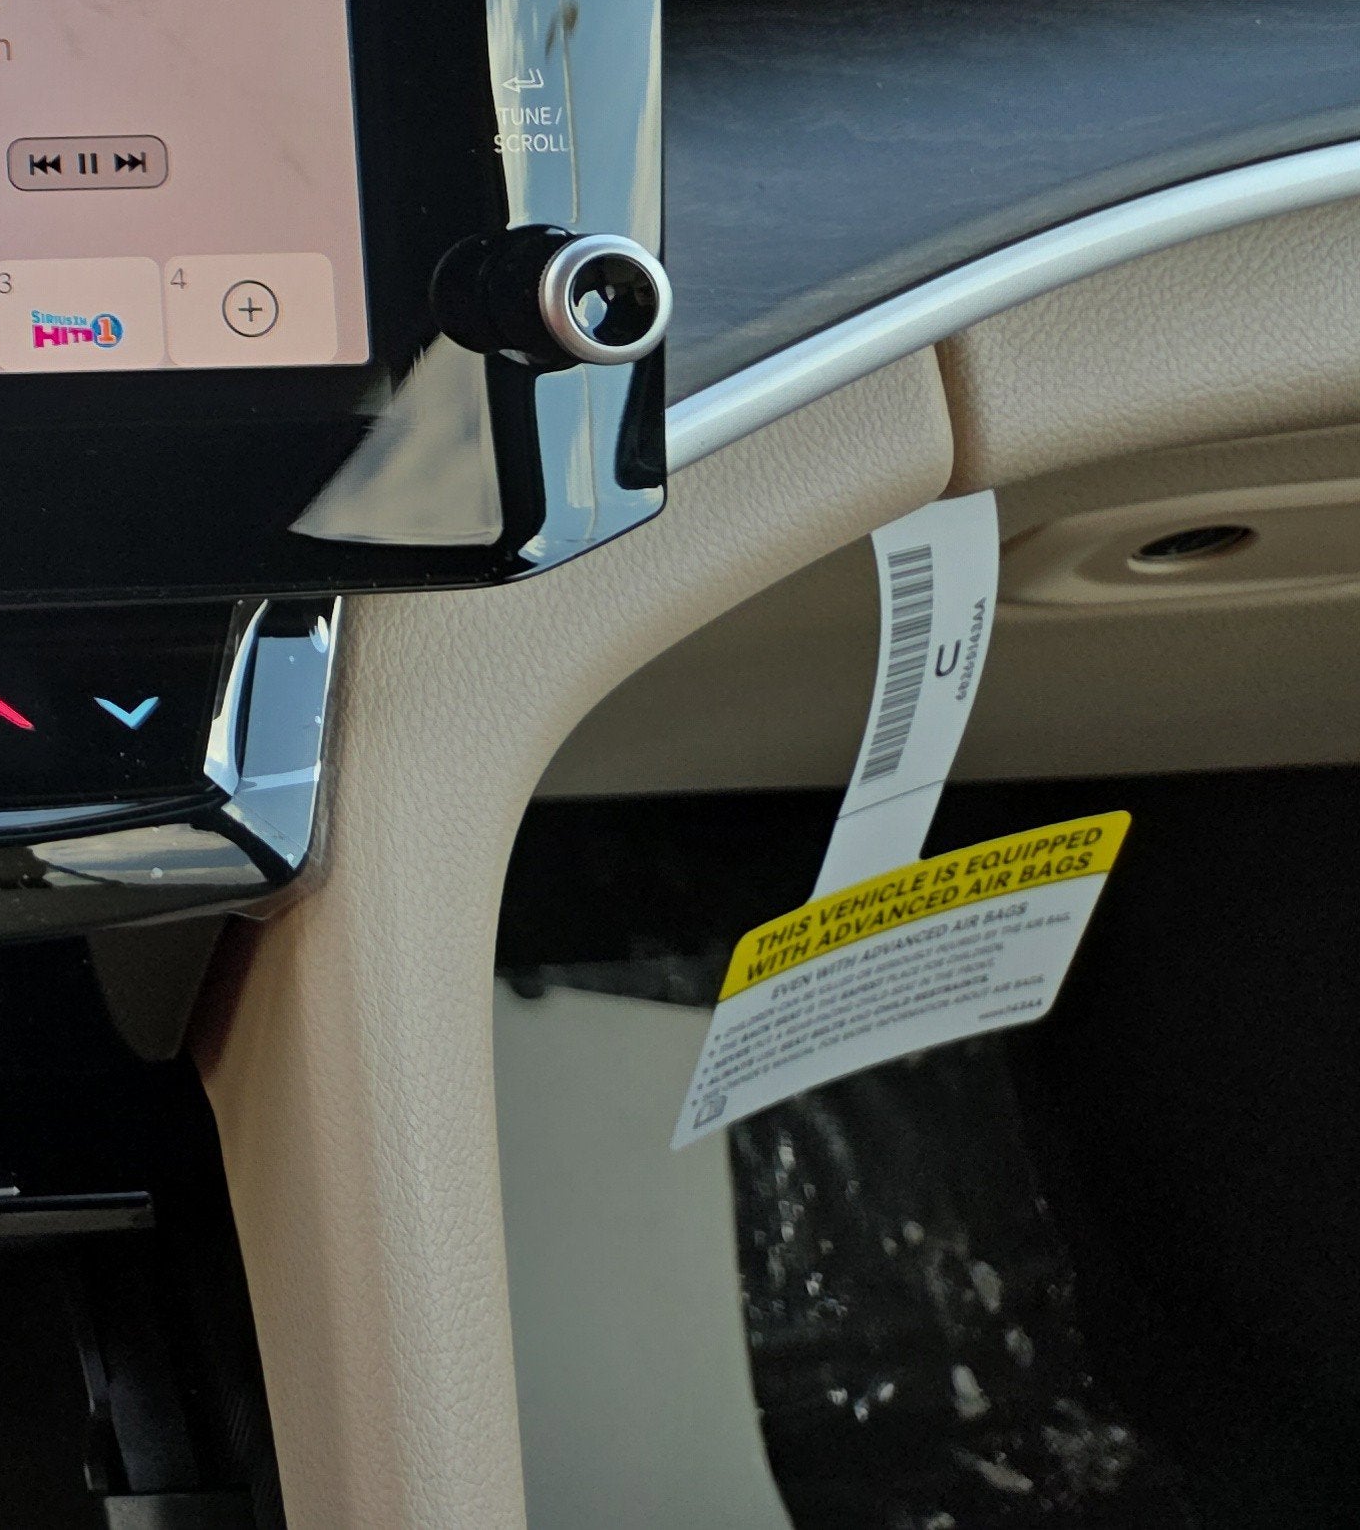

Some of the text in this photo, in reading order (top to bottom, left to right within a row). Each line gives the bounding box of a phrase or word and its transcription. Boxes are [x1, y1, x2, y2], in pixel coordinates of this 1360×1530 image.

[499, 106, 563, 125] TUNE/
[493, 132, 570, 154] SCROLL
[170, 268, 187, 289] 4
[98, 317, 116, 344] 1
[755, 826, 1104, 956] THIS VEHICLE IS EQUIPPED
[746, 851, 1094, 982] WITH ADVANCED AIR BAGS
